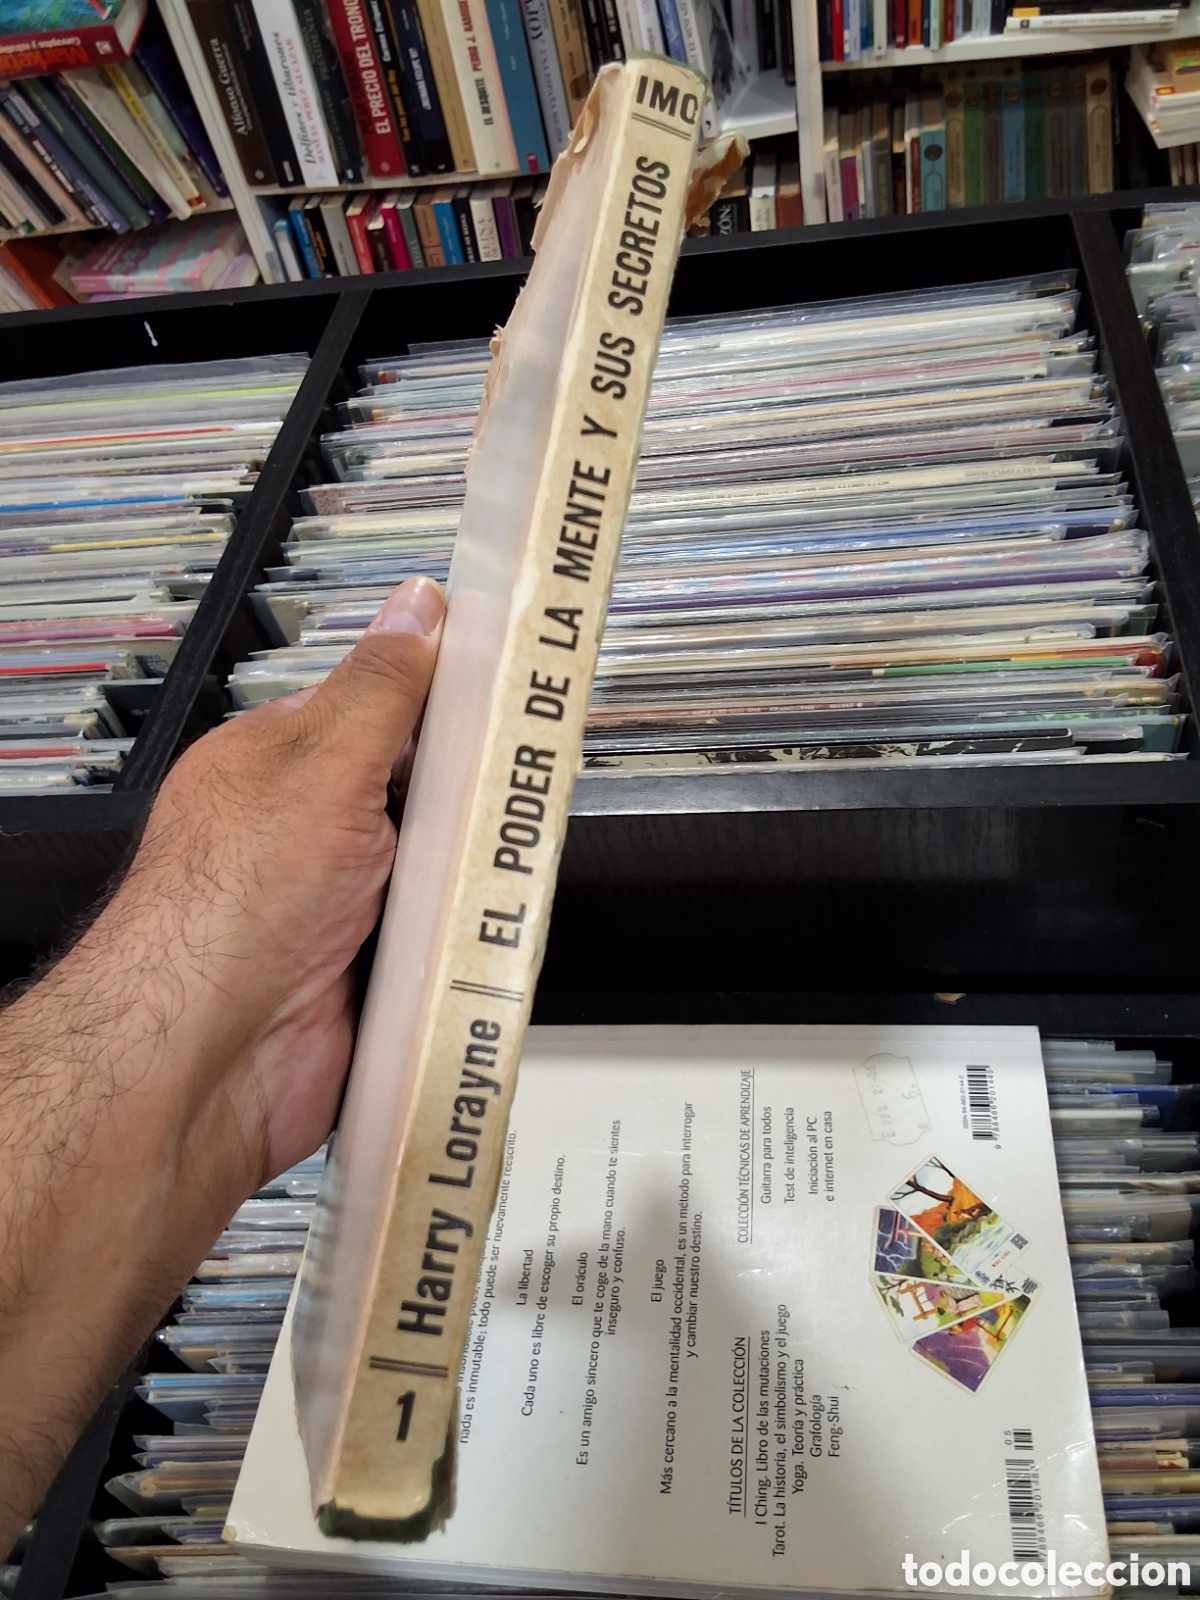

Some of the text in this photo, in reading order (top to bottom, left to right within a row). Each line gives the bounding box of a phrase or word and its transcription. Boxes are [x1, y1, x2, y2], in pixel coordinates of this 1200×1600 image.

[209, 38, 231, 84] Guerra
[355, 42, 374, 68] DEL
[378, 33, 392, 62] Carmen
[468, 45, 482, 72] PEDRO
[226, 86, 248, 136] Alfonso
[362, 69, 386, 118] PRECIO
[484, 116, 494, 126] EL
[375, 118, 391, 134] EL
[478, 156, 670, 949] EL PODER DE LA MENTE Y SUS SECRETOS
[824, 1111, 833, 1134] casa
[824, 1136, 834, 1150] en
[396, 1016, 502, 1338] Harry Lorayne
[737, 1069, 752, 1244] COLECCIÓN TÉCNICAS DE APRENDIZAJE
[760, 1106, 775, 1204] Guitarra para todos
[783, 1107, 798, 1204] Test de inteligencia
[806, 1117, 819, 1195] Iniciación al PC
[823, 1152, 835, 1192] internet
[460, 1130, 517, 1444] nada es inmutable; todo puede ser nuevamente reescrito.
[515, 1249, 534, 1306] La libertad
[520, 1155, 566, 1417] Cada uno es libre de escoger su propio destino.
[571, 1251, 589, 1306] El oráculo
[575, 1120, 621, 1466] Es un amigo sincero que te coge de la mano cuando te sientes
[605, 1227, 626, 1335] inseguro y confuso.
[650, 1259, 667, 1303] El juego
[659, 1102, 696, 1494] Más cercano a la mentalidad occidental, es un método para interrogar
[685, 1212, 703, 1359] y cambiar nuestro destino.
[758, 1330, 770, 1397] mutaciones
[396, 1389, 416, 1443] 1
[728, 1337, 746, 1515] TÍTULOS DE LA COLECCIÓN
[756, 1400, 770, 1417] las
[756, 1420, 769, 1436] de
[772, 1304, 790, 1555] Tarot. La historia, el simbolismo y el juego
[791, 1359, 807, 1495] Yoga. Teoría y práctica
[809, 1394, 825, 1458] Grafología
[826, 1396, 843, 1458] Feng-Shui
[755, 1439, 769, 1472] Libro
[754, 1476, 769, 1517] Ching.
